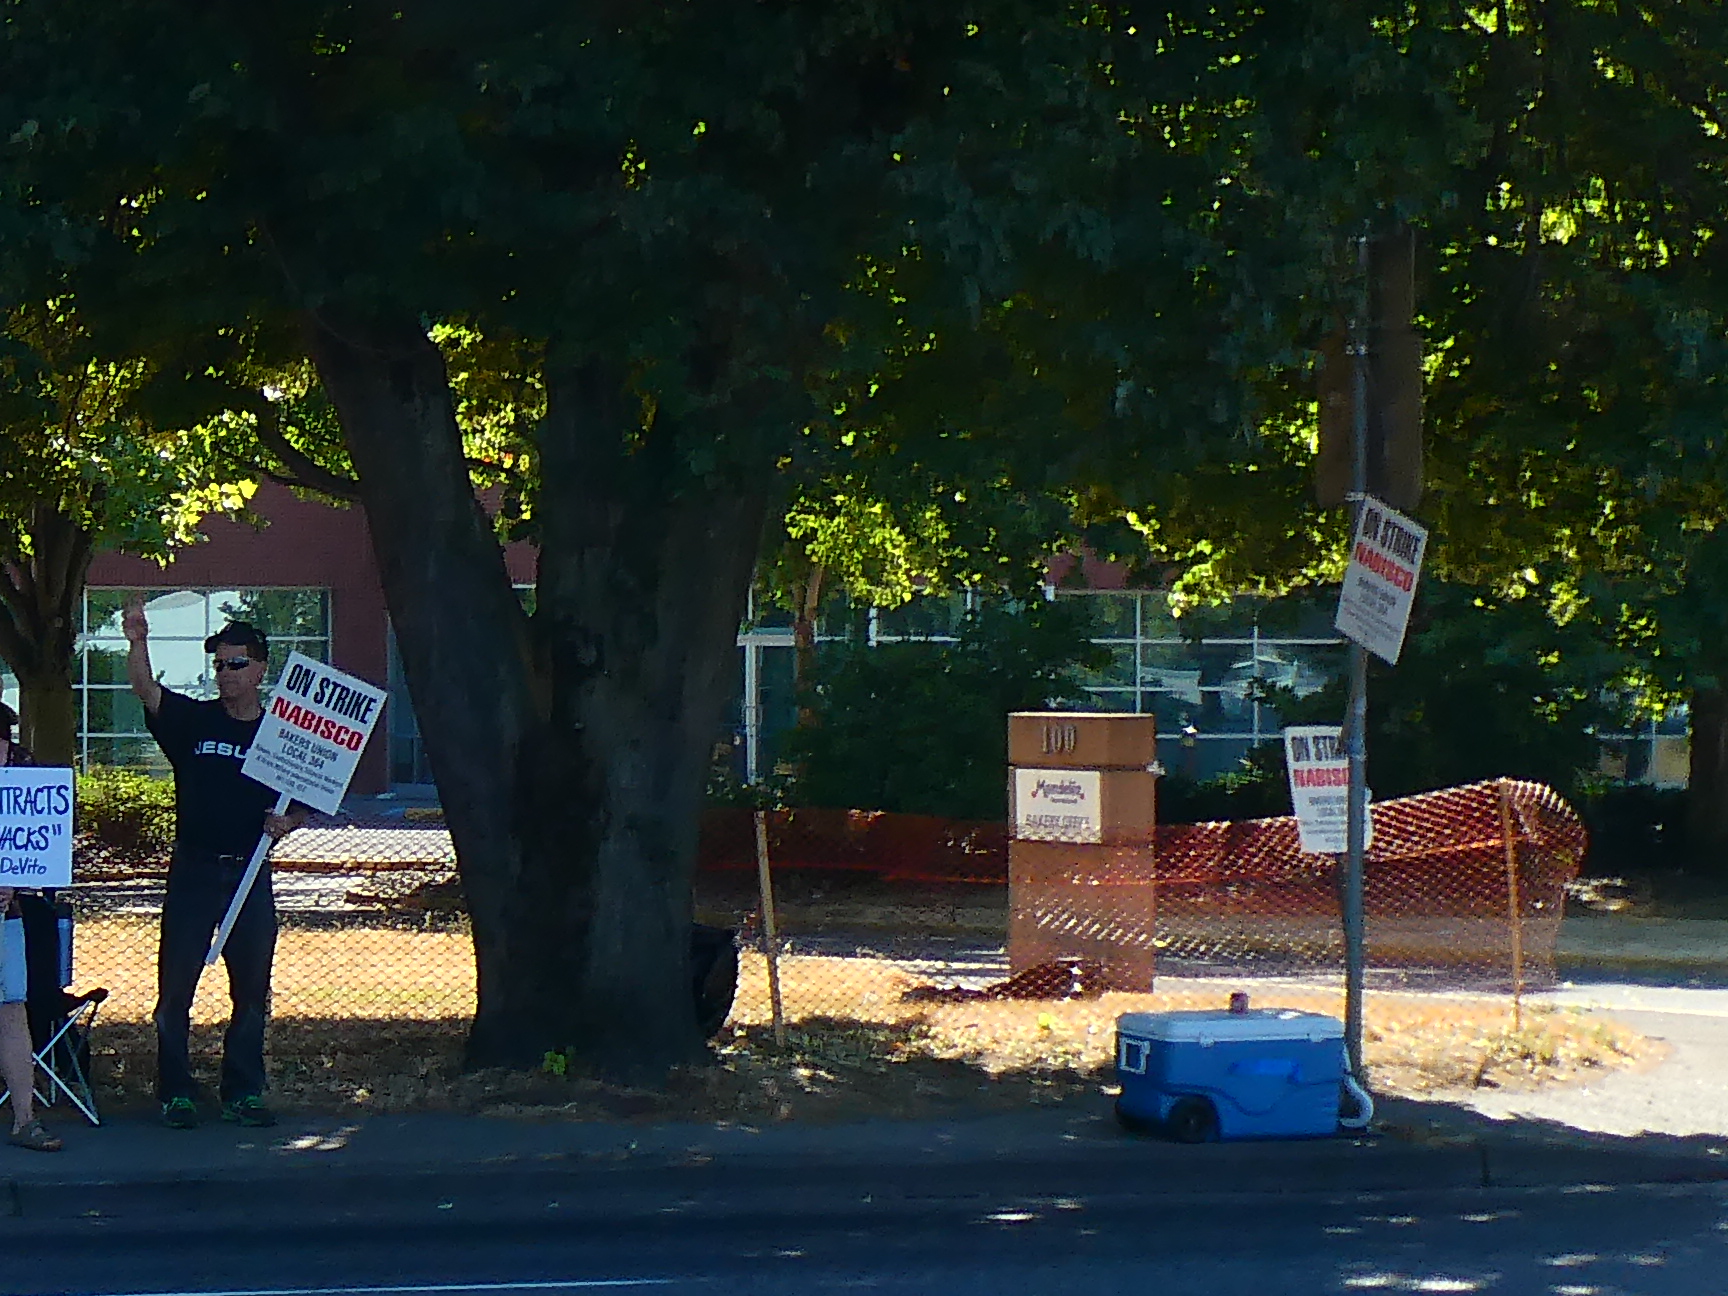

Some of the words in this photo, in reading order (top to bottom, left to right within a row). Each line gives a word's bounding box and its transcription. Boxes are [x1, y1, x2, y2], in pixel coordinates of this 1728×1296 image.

[1354, 542, 1415, 592] NABISCO
[286, 664, 316, 697] ON
[313, 677, 377, 724] STRIKE
[271, 696, 364, 752] NABISCO
[0, 856, 48, 876] DeVito
